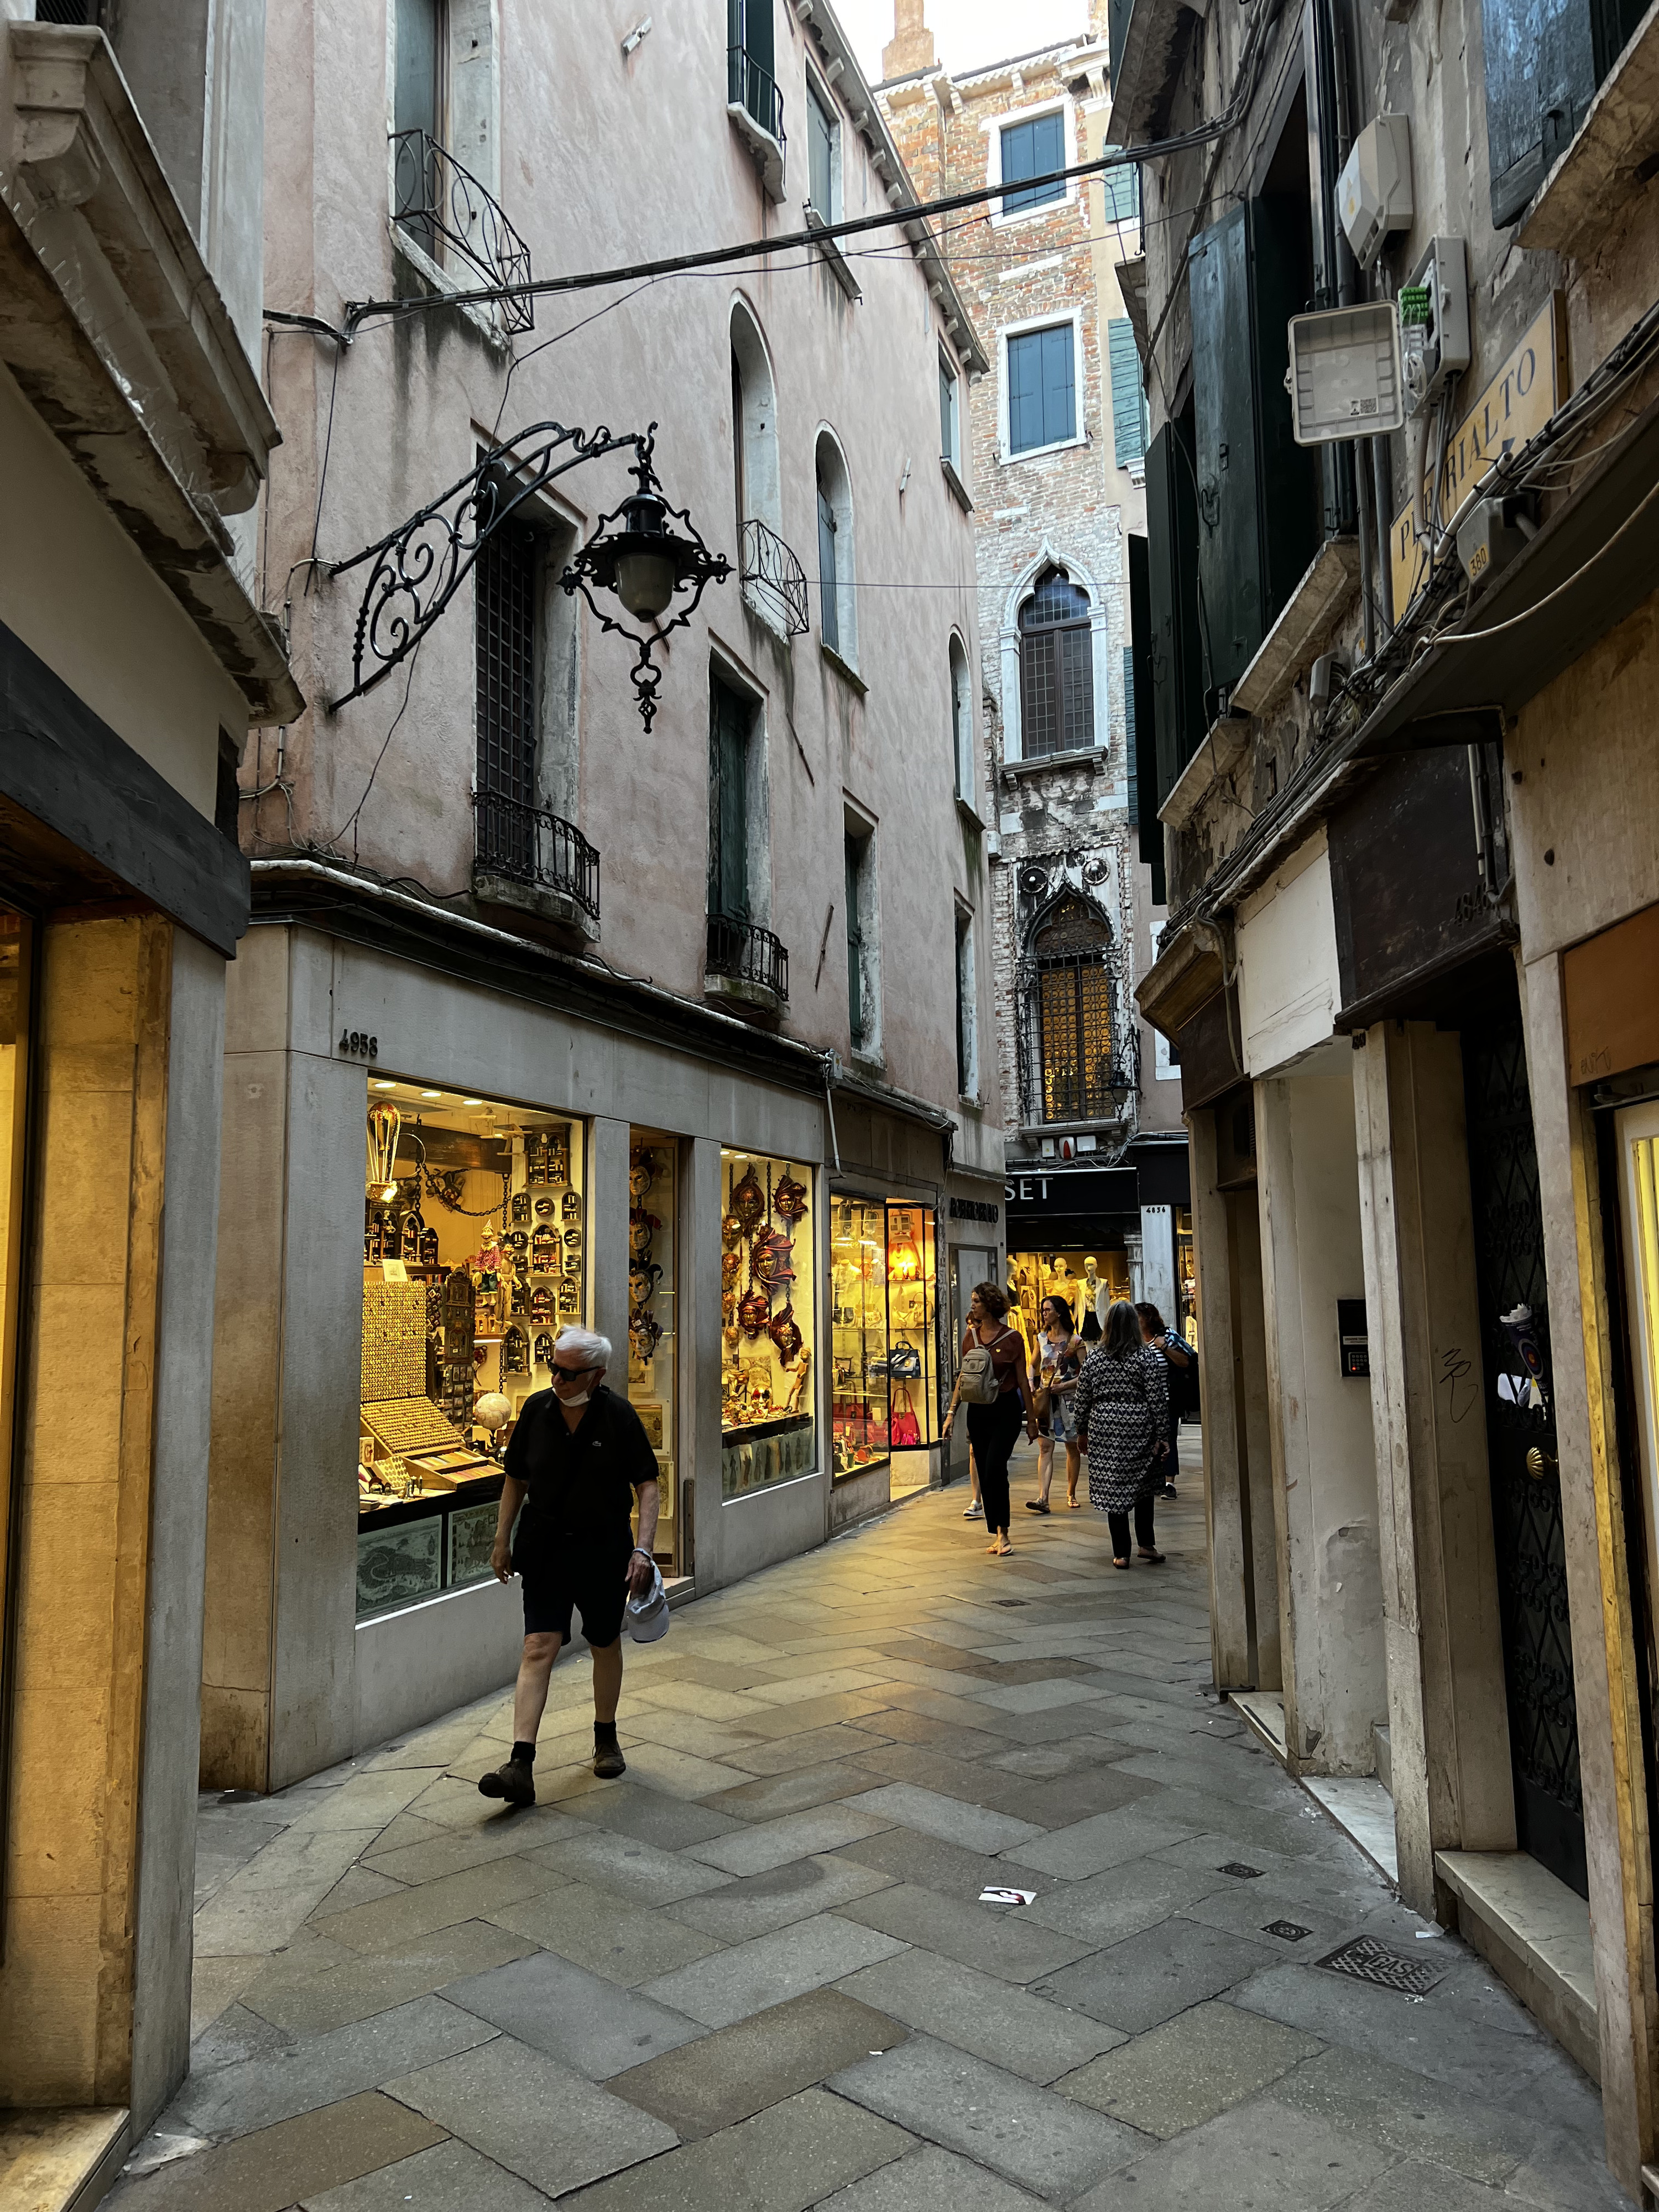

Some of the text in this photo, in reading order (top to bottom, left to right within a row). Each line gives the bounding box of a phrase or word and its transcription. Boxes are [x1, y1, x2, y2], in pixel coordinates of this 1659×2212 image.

[1445, 348, 1536, 501] RIALTO
[1470, 547, 1487, 577] 380
[339, 1029, 378, 1056] 4958
[1368, 1955, 1415, 1974] GAS
